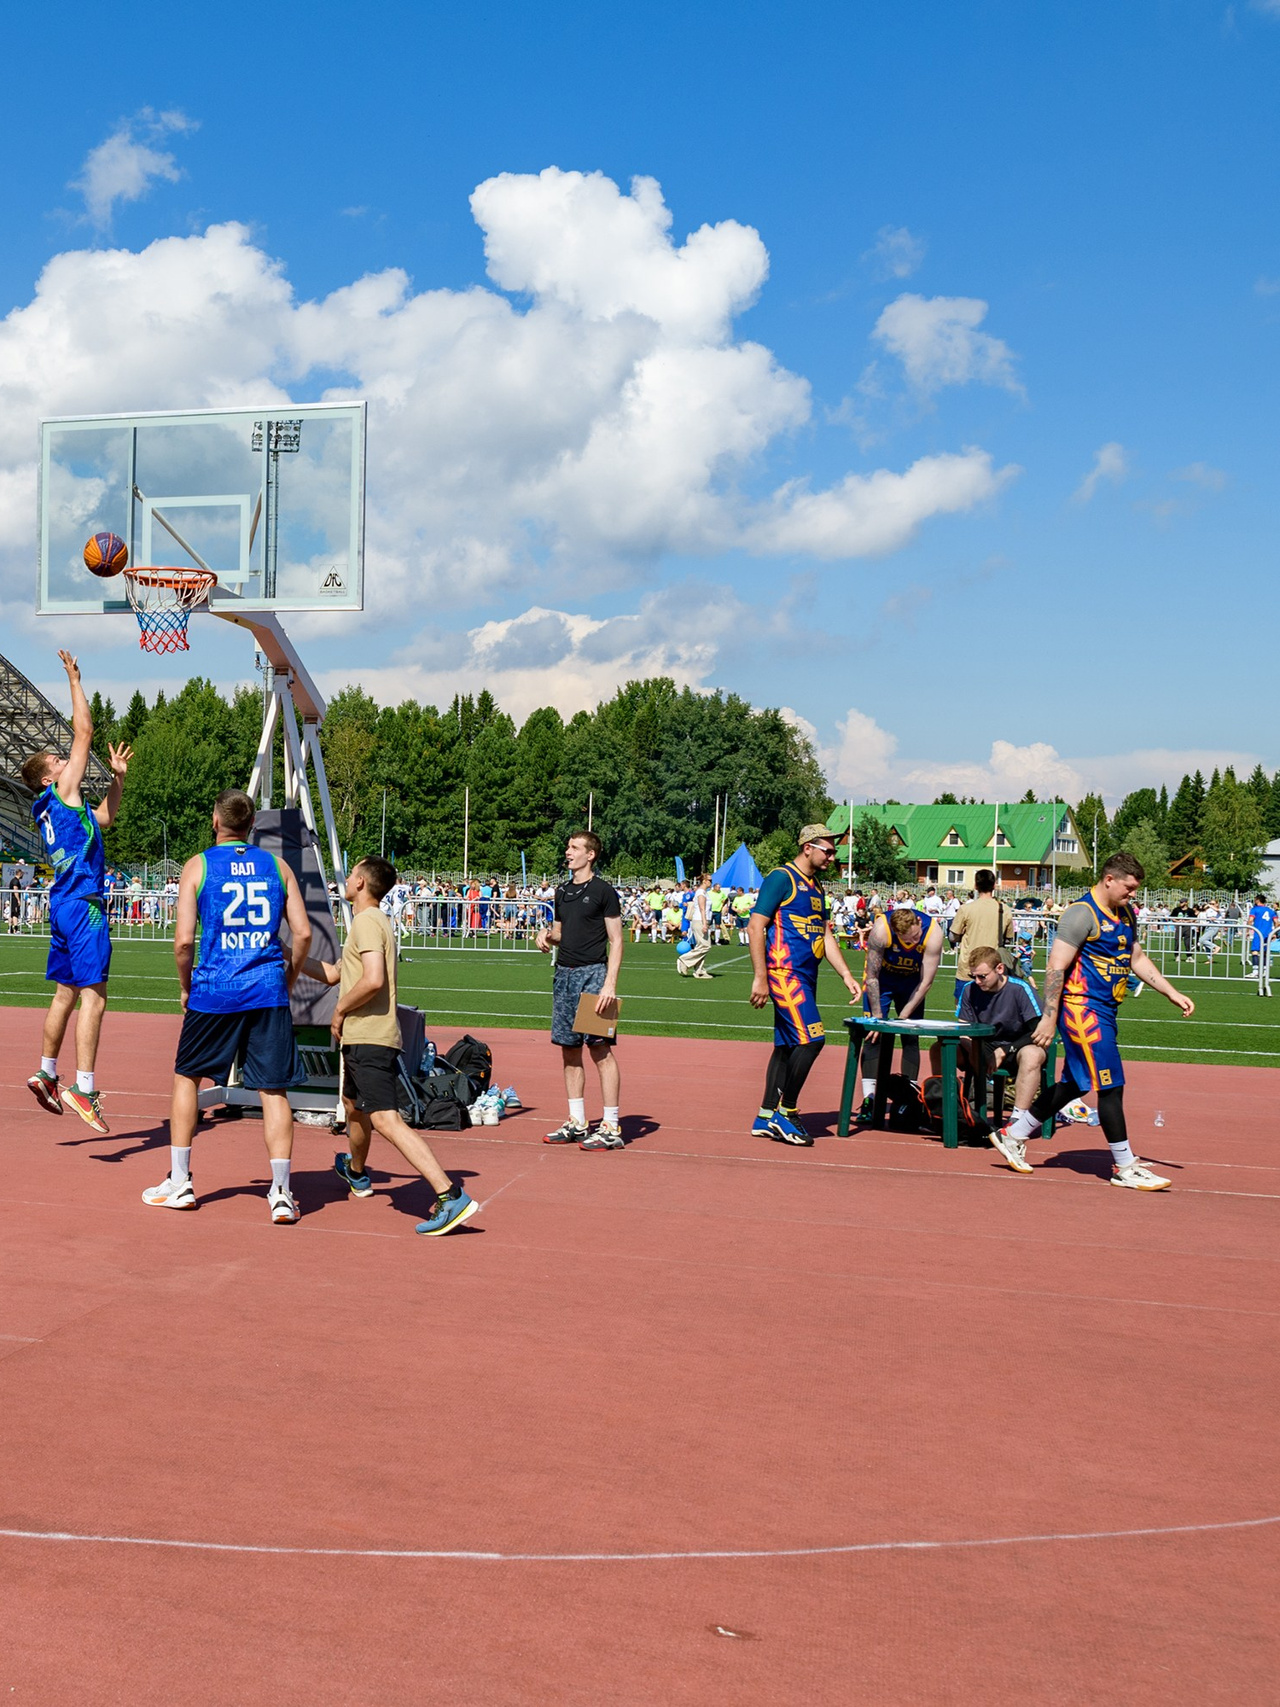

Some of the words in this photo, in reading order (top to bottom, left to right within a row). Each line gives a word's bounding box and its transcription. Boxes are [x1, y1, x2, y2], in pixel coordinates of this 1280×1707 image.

[40, 809, 55, 846] 8
[230, 862, 255, 876] ВАЛ
[221, 881, 271, 926] 25
[1262, 910, 1270, 921] 4
